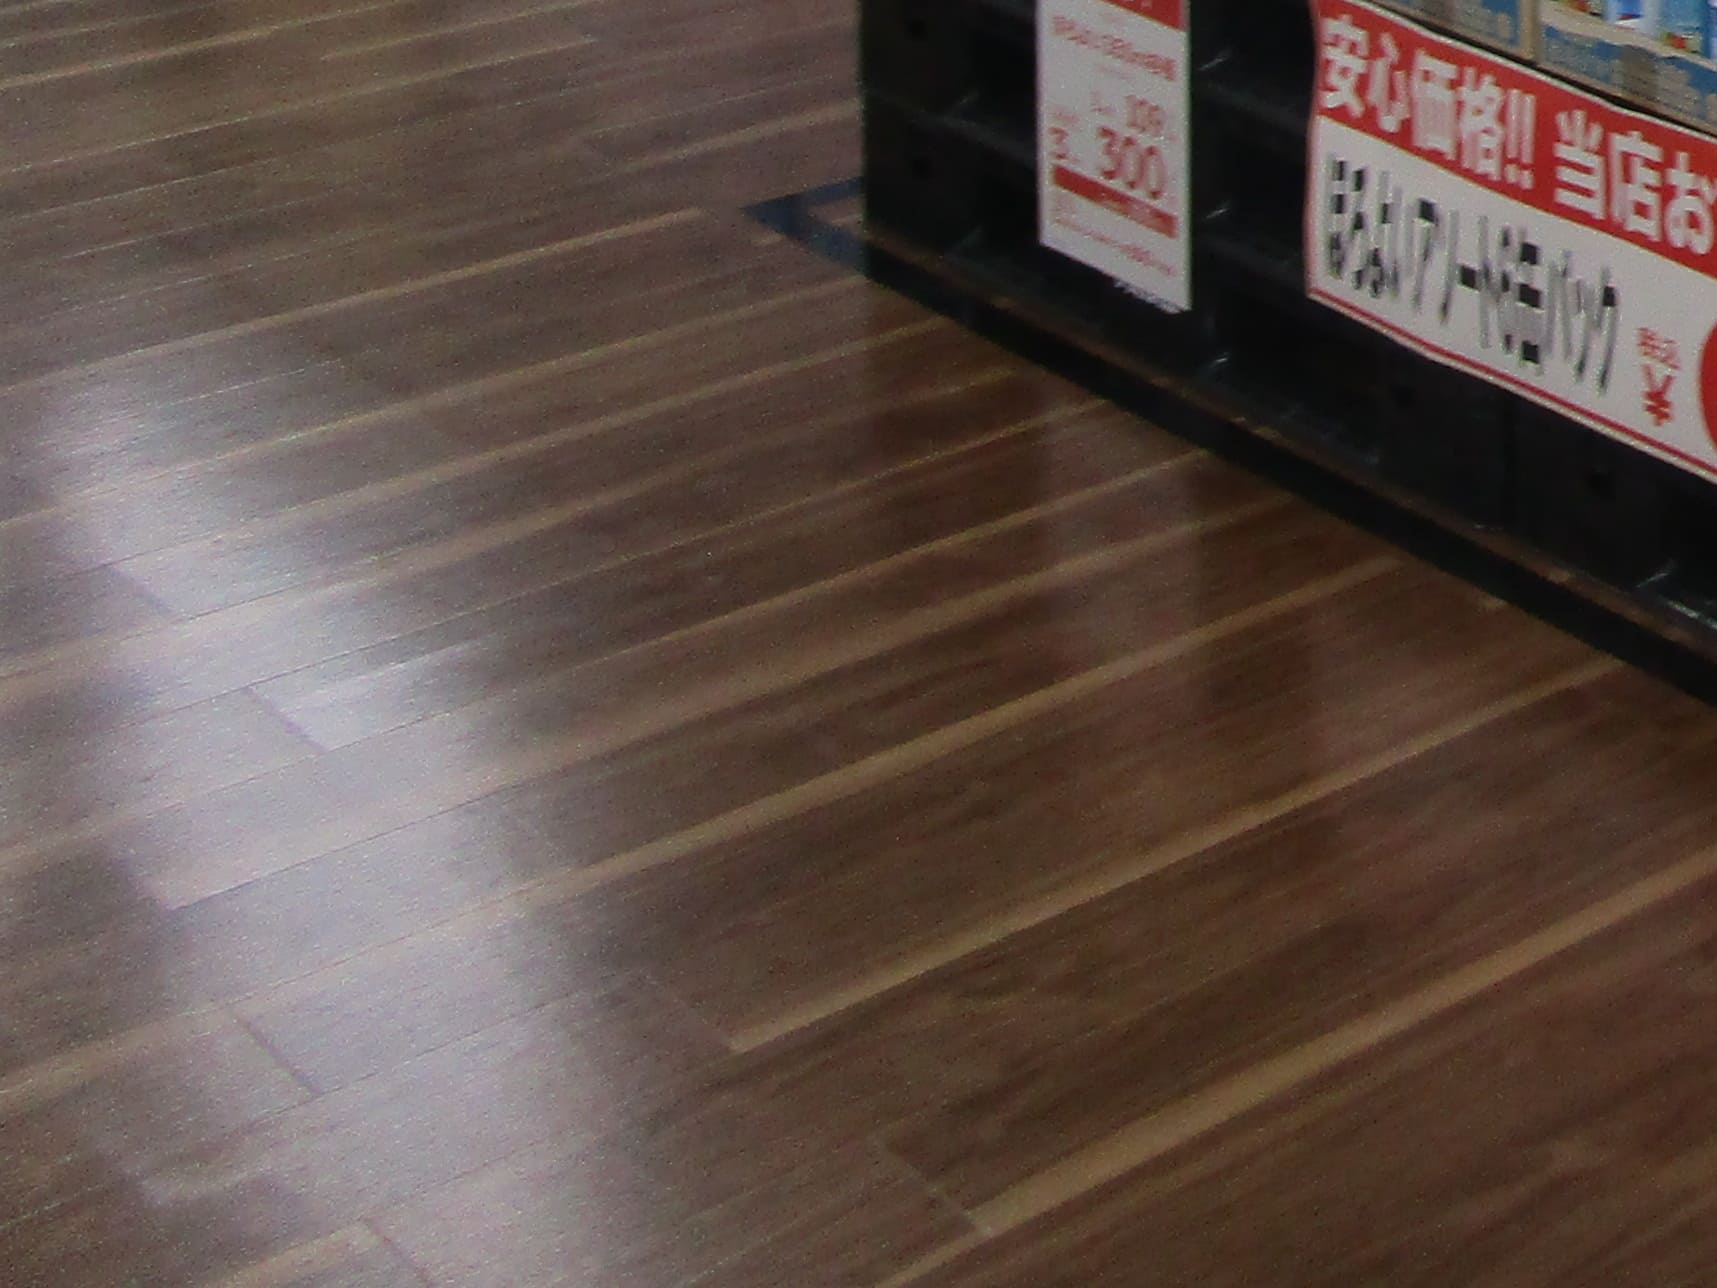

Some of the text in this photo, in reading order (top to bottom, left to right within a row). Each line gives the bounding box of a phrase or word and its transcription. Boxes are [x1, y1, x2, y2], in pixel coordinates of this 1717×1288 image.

[1097, 125, 1168, 200] 300
[1318, 12, 1537, 191] 安心価格!!
